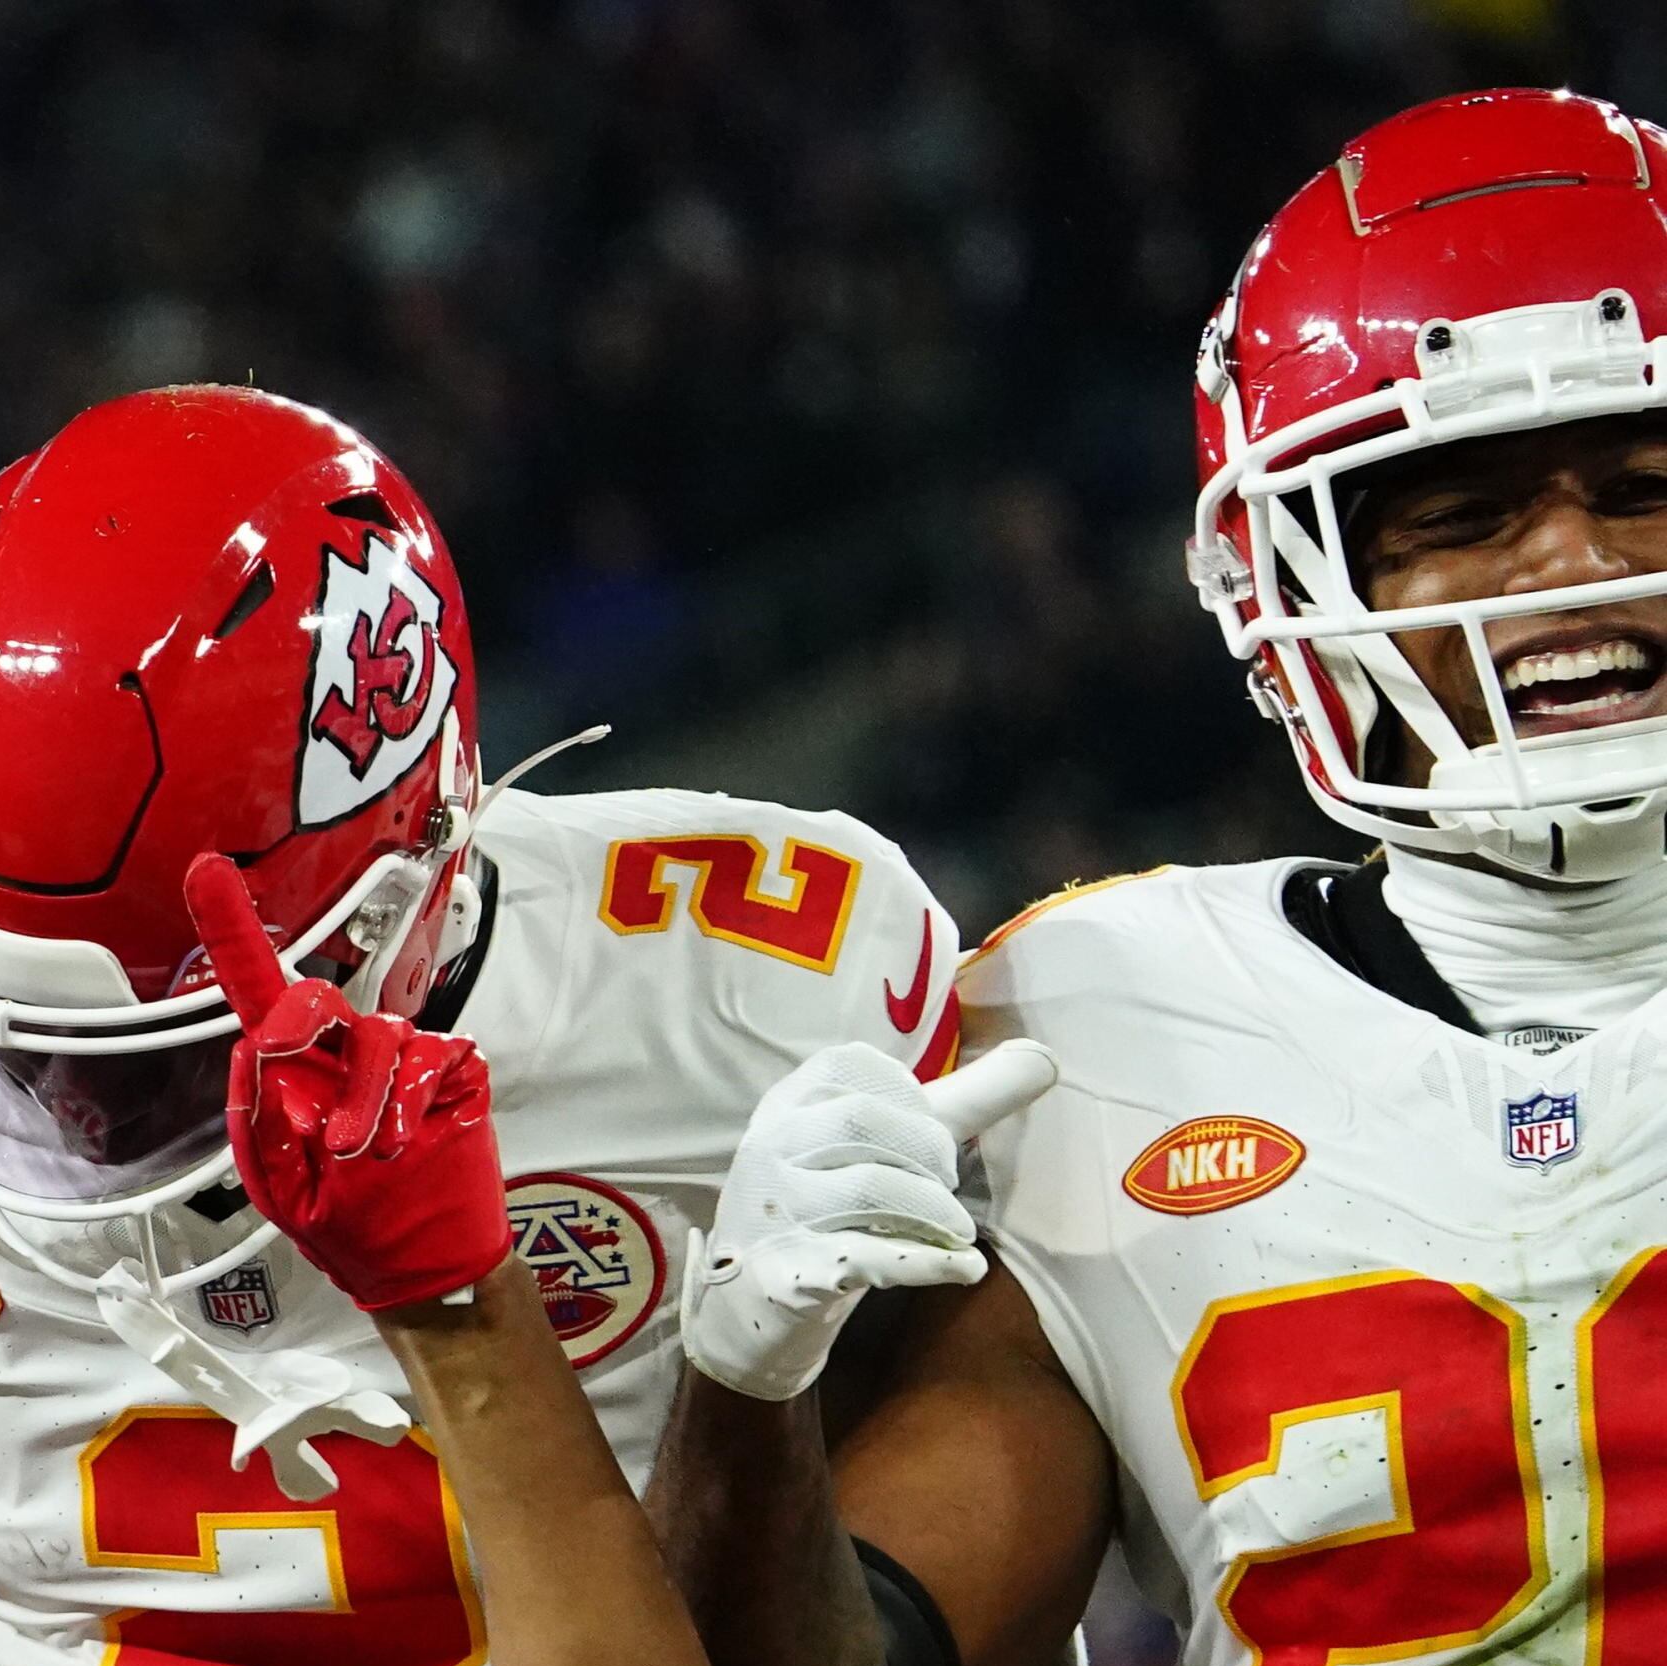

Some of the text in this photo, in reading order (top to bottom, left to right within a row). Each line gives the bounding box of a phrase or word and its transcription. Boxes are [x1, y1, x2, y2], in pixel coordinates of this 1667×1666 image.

[596, 832, 865, 978] 2
[1514, 1028, 1591, 1046] EQUIPMEN
[1515, 1121, 1572, 1155] NFL
[1166, 1137, 1258, 1191] NKH
[210, 1291, 266, 1324] NFL
